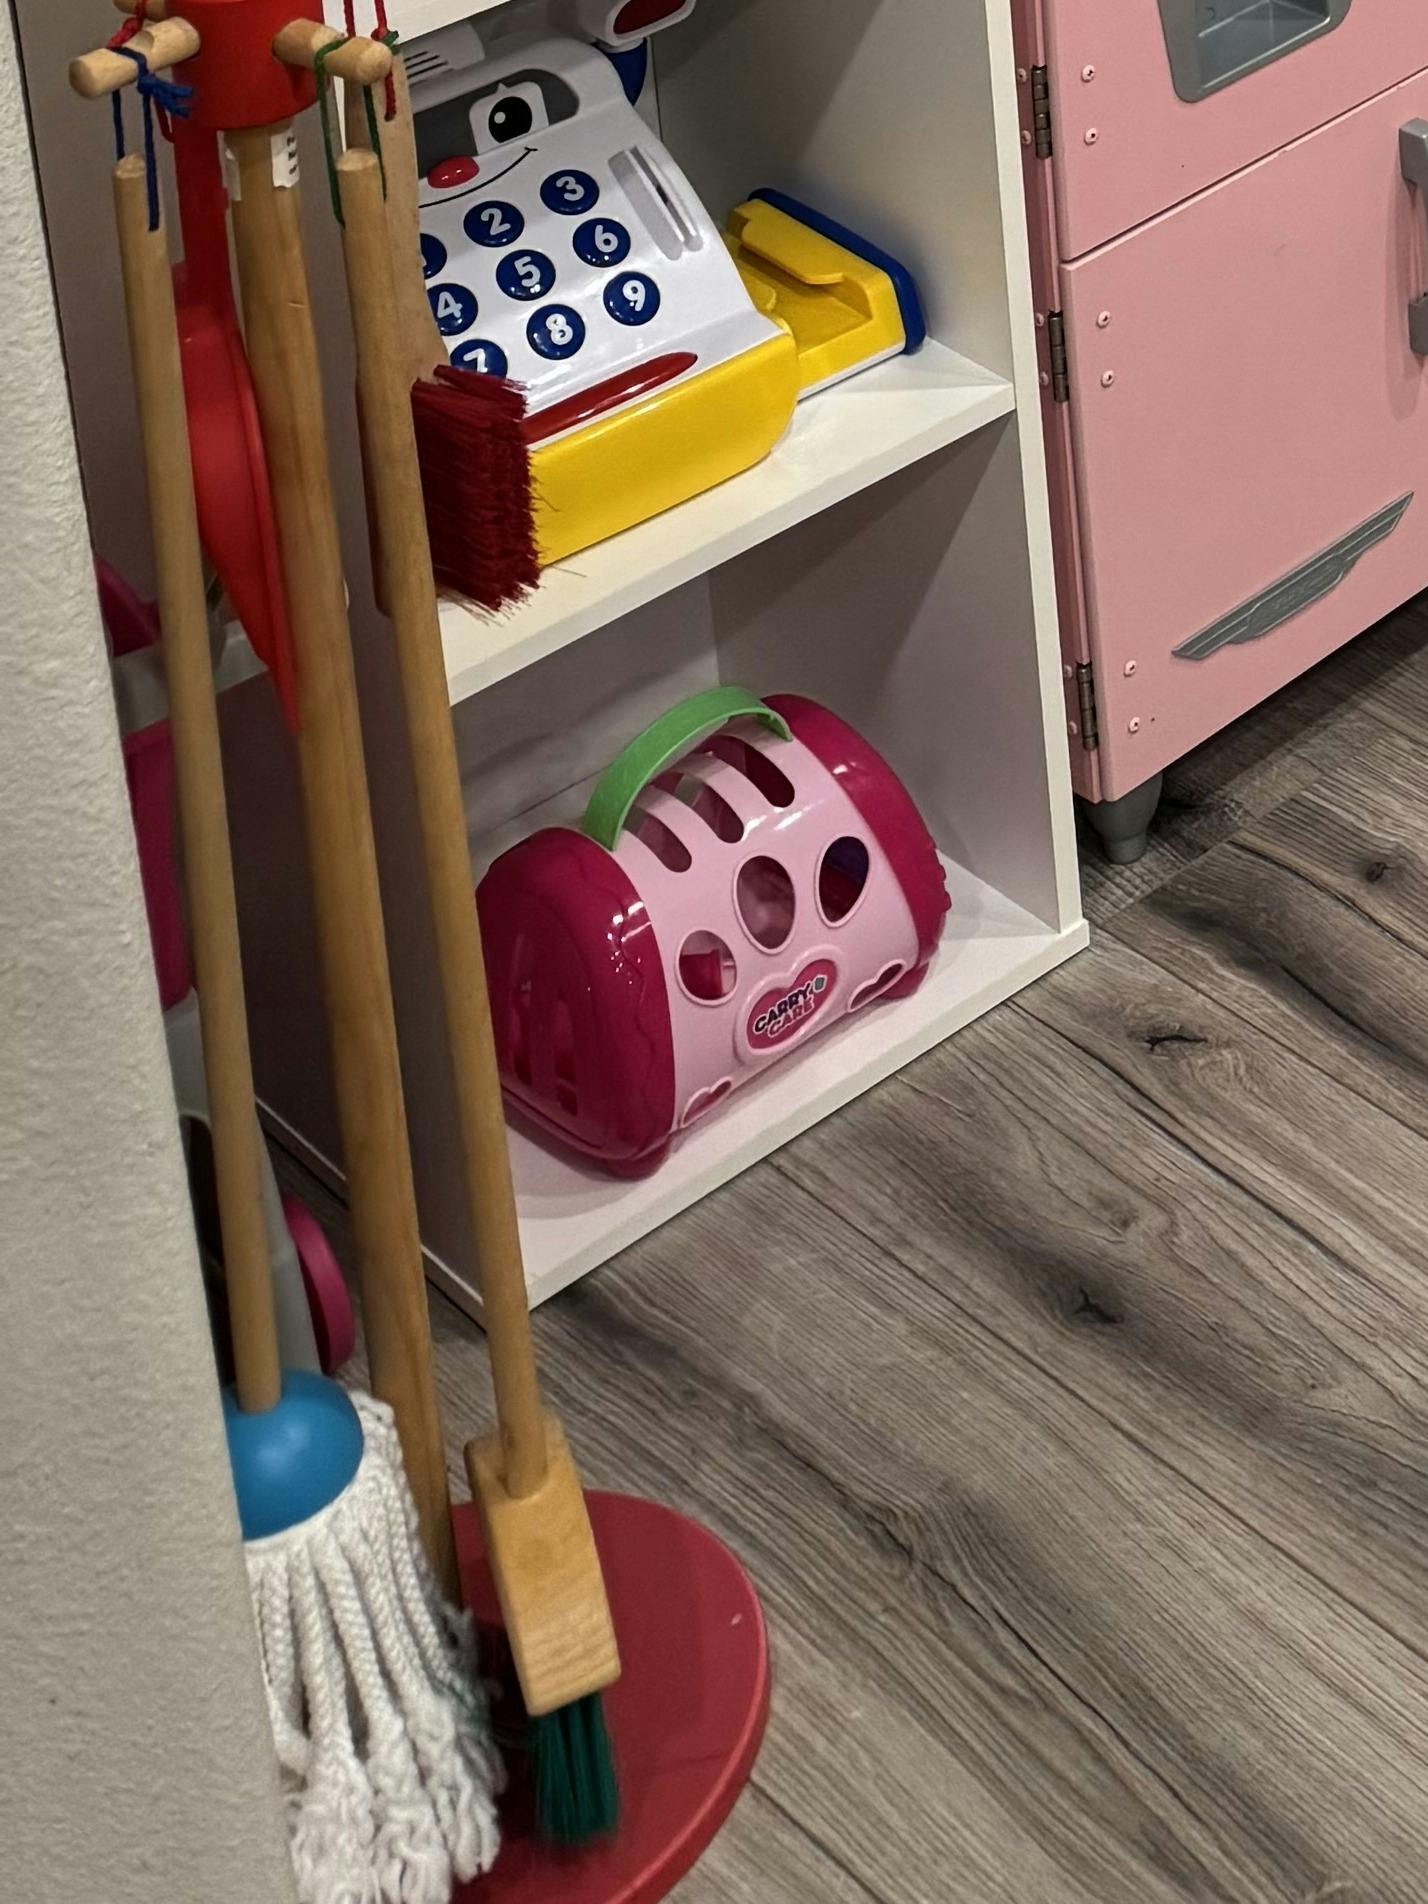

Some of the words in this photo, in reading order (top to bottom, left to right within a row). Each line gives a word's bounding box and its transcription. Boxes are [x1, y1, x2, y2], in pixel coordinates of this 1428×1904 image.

[545, 313, 574, 345] 8
[622, 280, 646, 311] 9
[753, 981, 812, 1034] CARRY
[768, 995, 814, 1038] CARE
